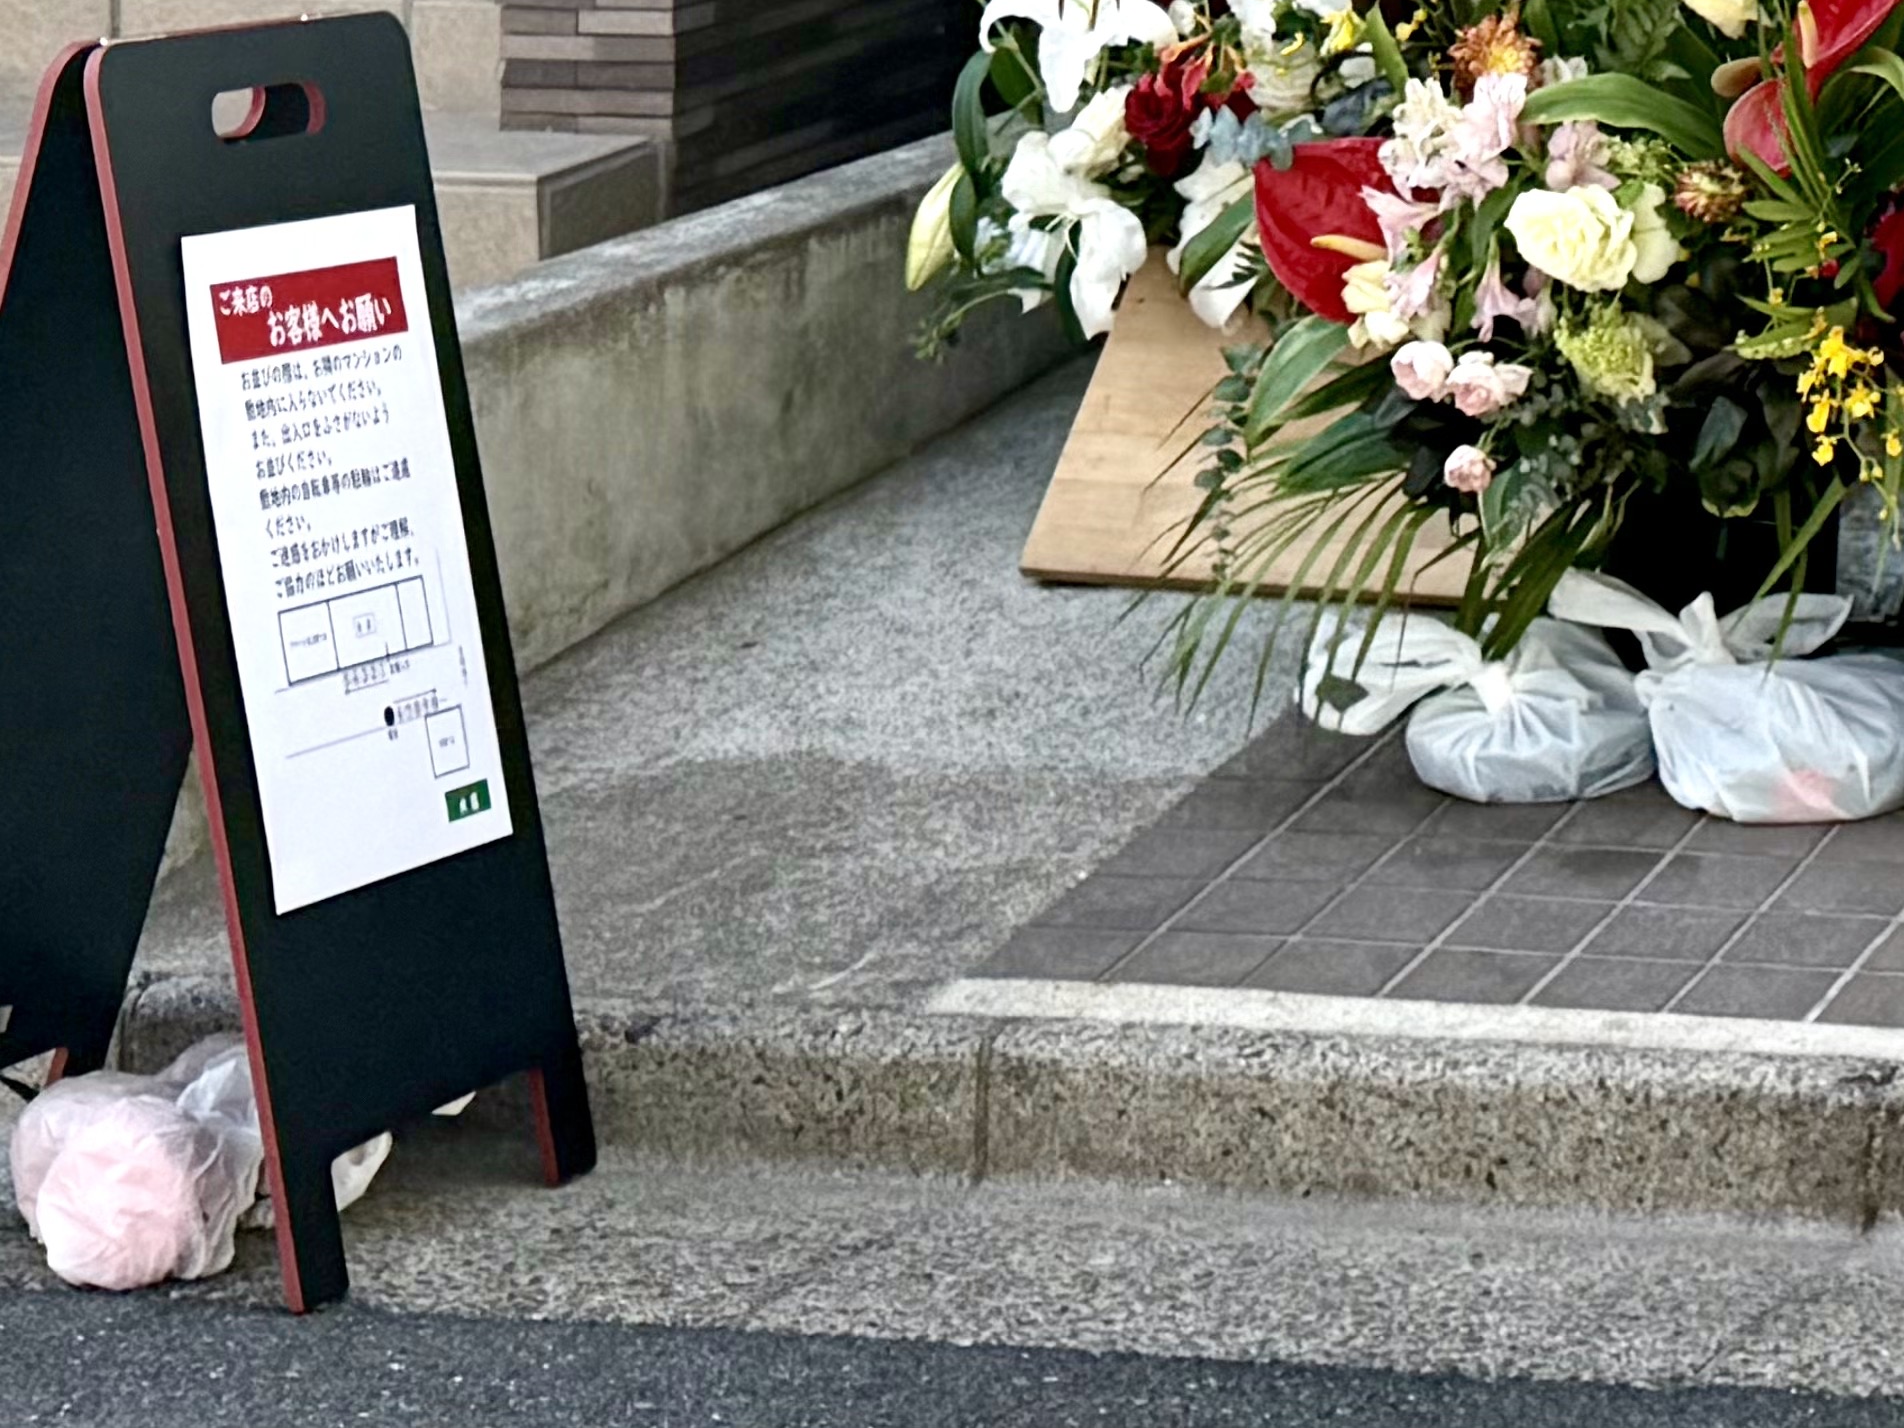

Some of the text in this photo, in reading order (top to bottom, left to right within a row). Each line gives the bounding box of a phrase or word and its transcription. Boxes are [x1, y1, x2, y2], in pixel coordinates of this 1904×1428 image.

[266, 292, 392, 348] お客様へお願い
